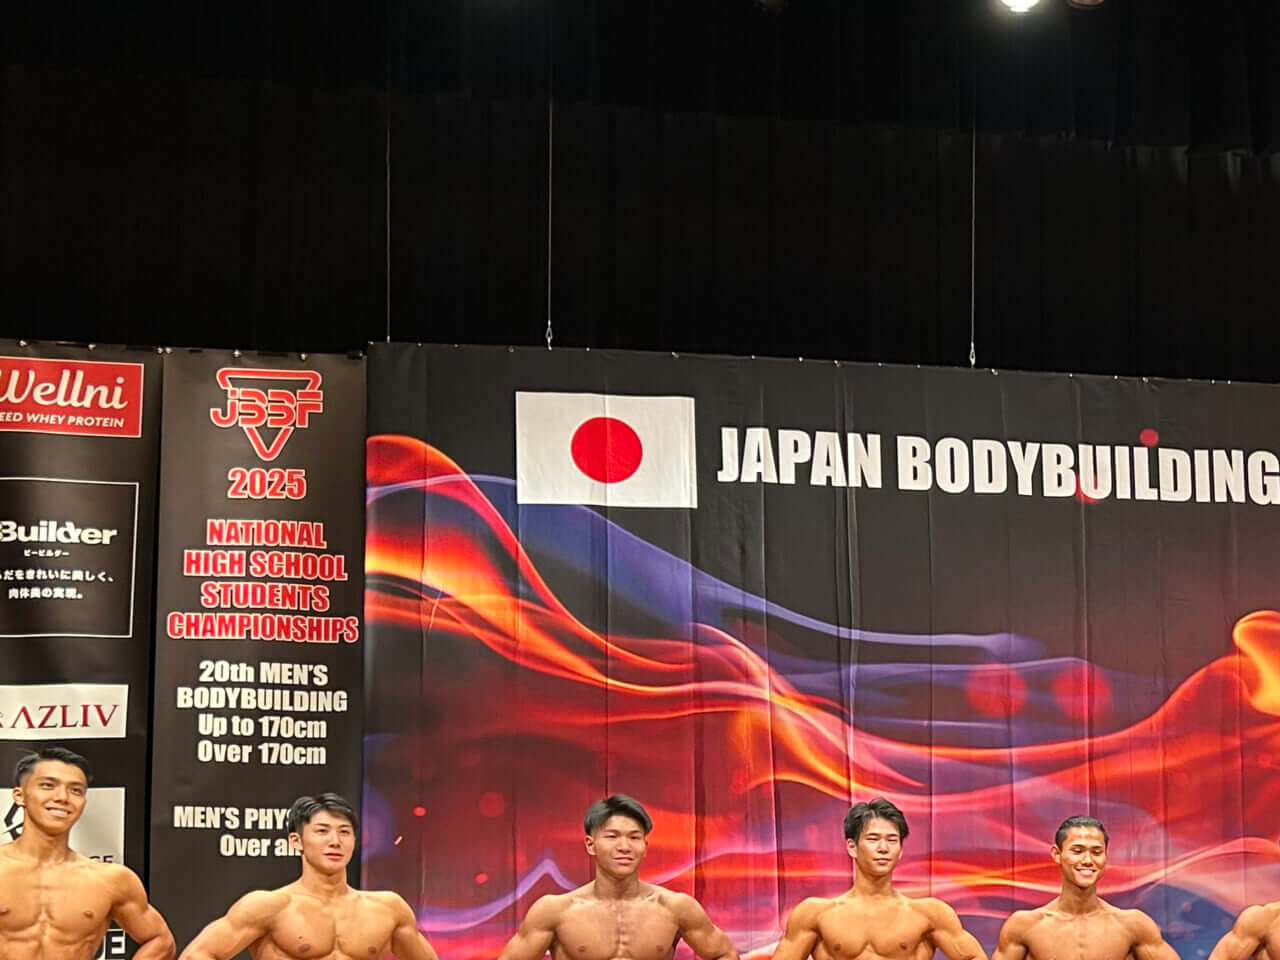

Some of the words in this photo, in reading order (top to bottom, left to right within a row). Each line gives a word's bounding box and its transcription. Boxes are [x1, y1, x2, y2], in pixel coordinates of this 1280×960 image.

[26, 413, 65, 425] WHEY
[67, 416, 124, 428] PROTEIN
[717, 427, 882, 489] JAPAN
[896, 434, 1280, 505] BODYBUILDING
[227, 467, 307, 500] 2025
[206, 518, 327, 549] NATIONAL
[183, 549, 246, 577] HIGH
[249, 551, 348, 581] SCHOOL
[200, 581, 330, 611] STUDENTS
[166, 611, 359, 643] CHAMPIONSHIPS
[198, 660, 255, 682] 20th
[259, 662, 328, 686] MEN'S
[176, 687, 348, 712] BODYBUILDING
[198, 713, 227, 737] Up
[231, 715, 255, 736] to
[258, 716, 327, 738] 170cm
[197, 740, 252, 763] Over
[258, 743, 327, 765] 170cm
[173, 806, 239, 829] MEN'S
[219, 834, 270, 857] Over
